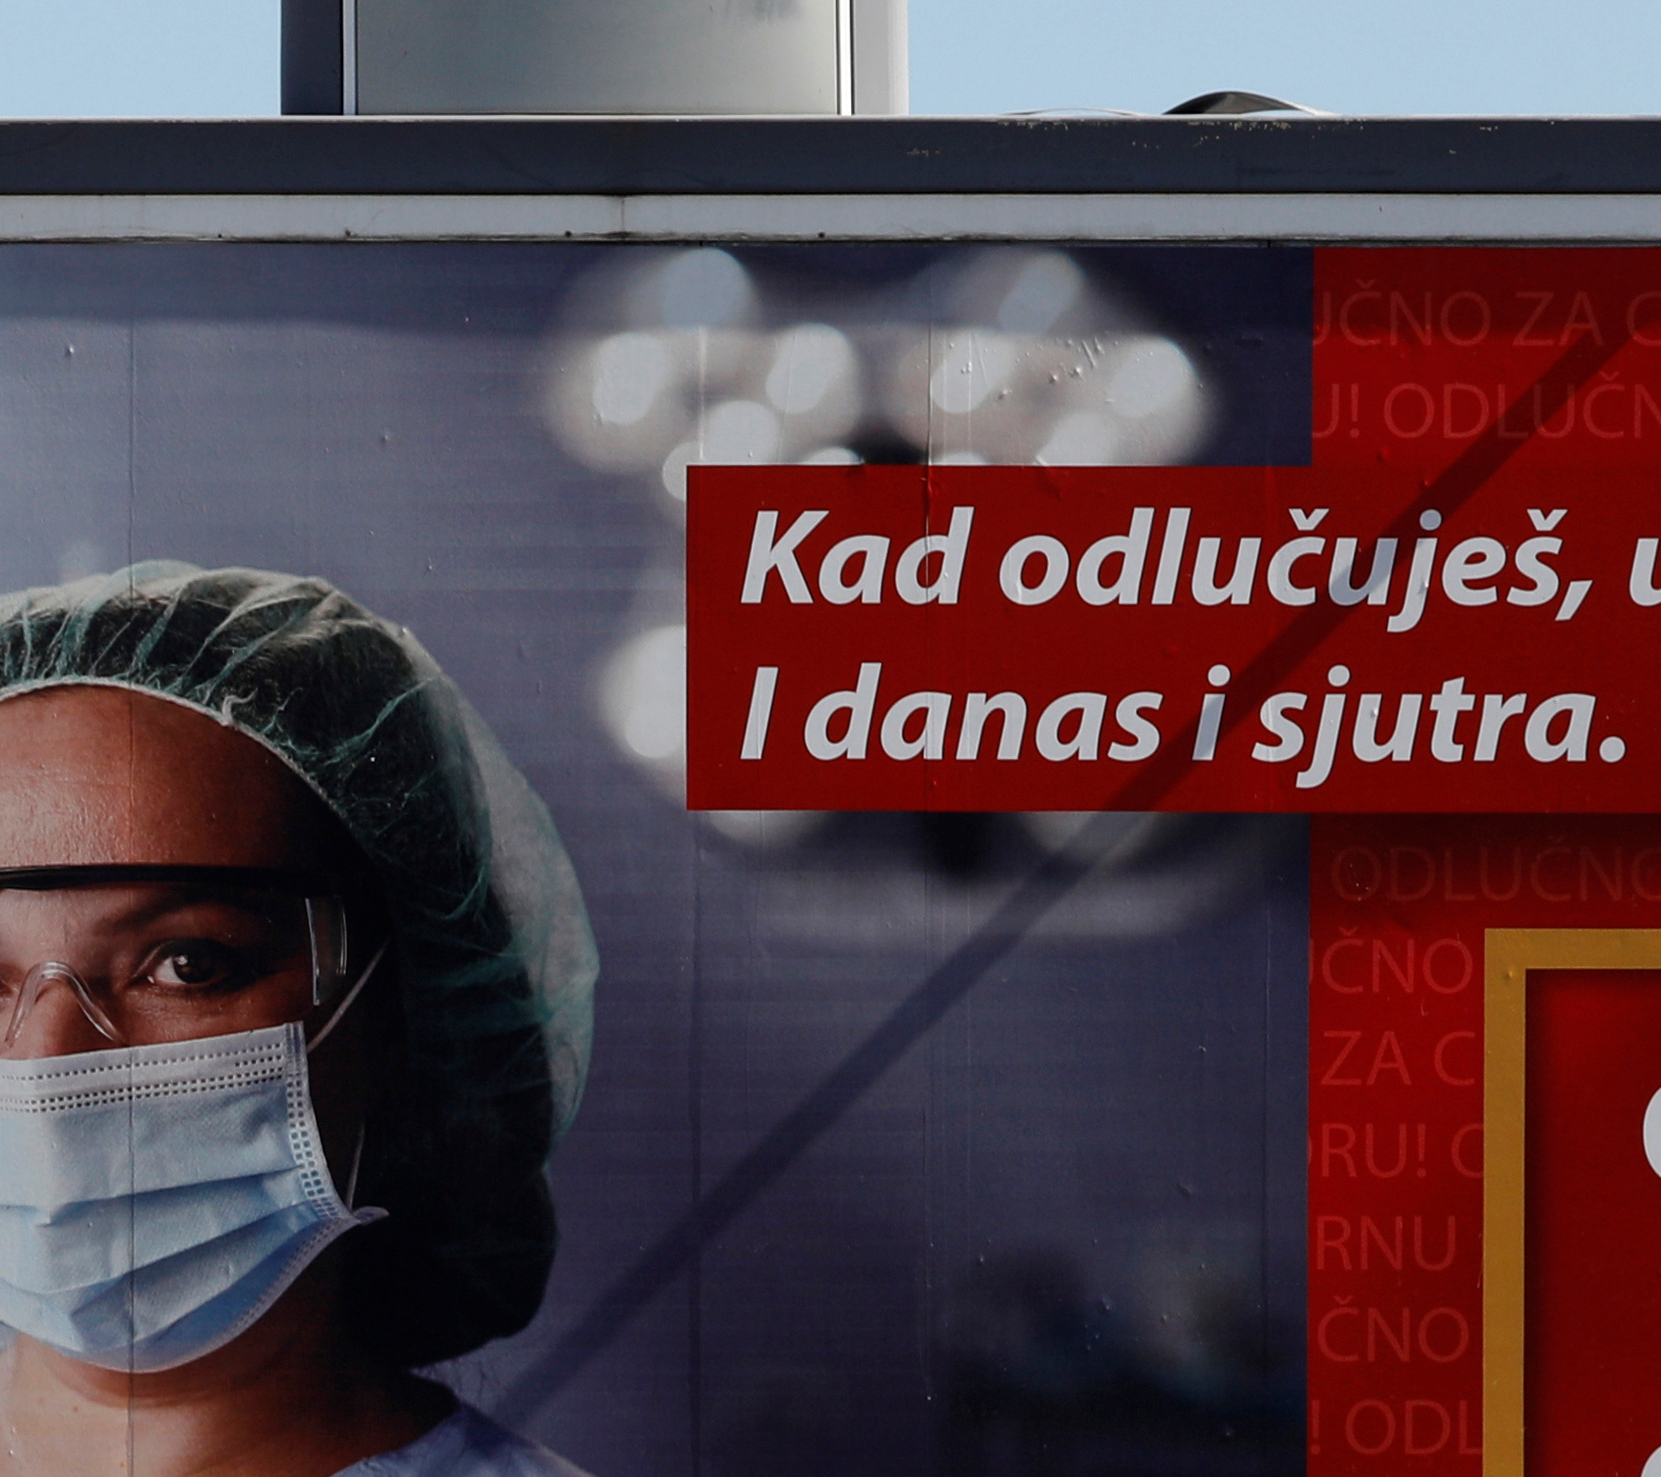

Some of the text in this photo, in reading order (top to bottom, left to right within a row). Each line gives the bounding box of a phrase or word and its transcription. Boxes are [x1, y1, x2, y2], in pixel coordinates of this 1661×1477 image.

[740, 506, 975, 605] Kad
[999, 507, 1593, 633] odlučuješ,
[740, 662, 1626, 789] I danas i sjutra.
[1309, 926, 1474, 993] ČNO
